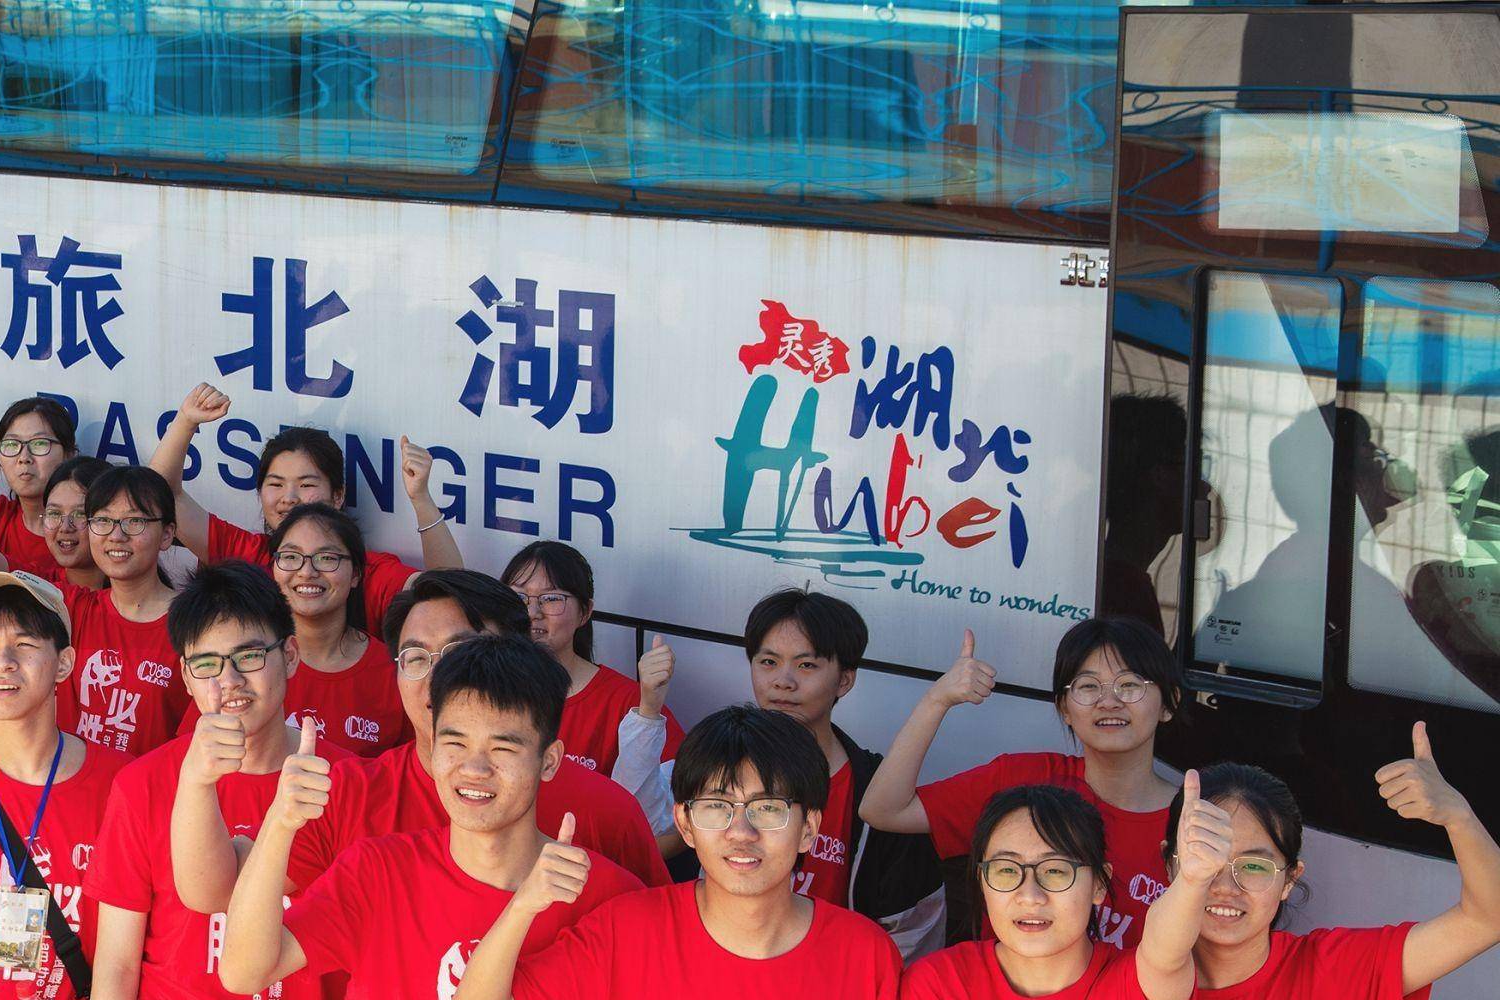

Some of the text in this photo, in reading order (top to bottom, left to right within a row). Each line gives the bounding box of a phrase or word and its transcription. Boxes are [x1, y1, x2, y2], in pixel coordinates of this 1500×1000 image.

[777, 323, 835, 379] 灵秀
[849, 335, 1032, 483] 湖北
[37, 391, 617, 549] ASSNGER
[714, 374, 1029, 569] Hubei
[891, 569, 1091, 622] Home to wonders
[104, 687, 142, 733] 必
